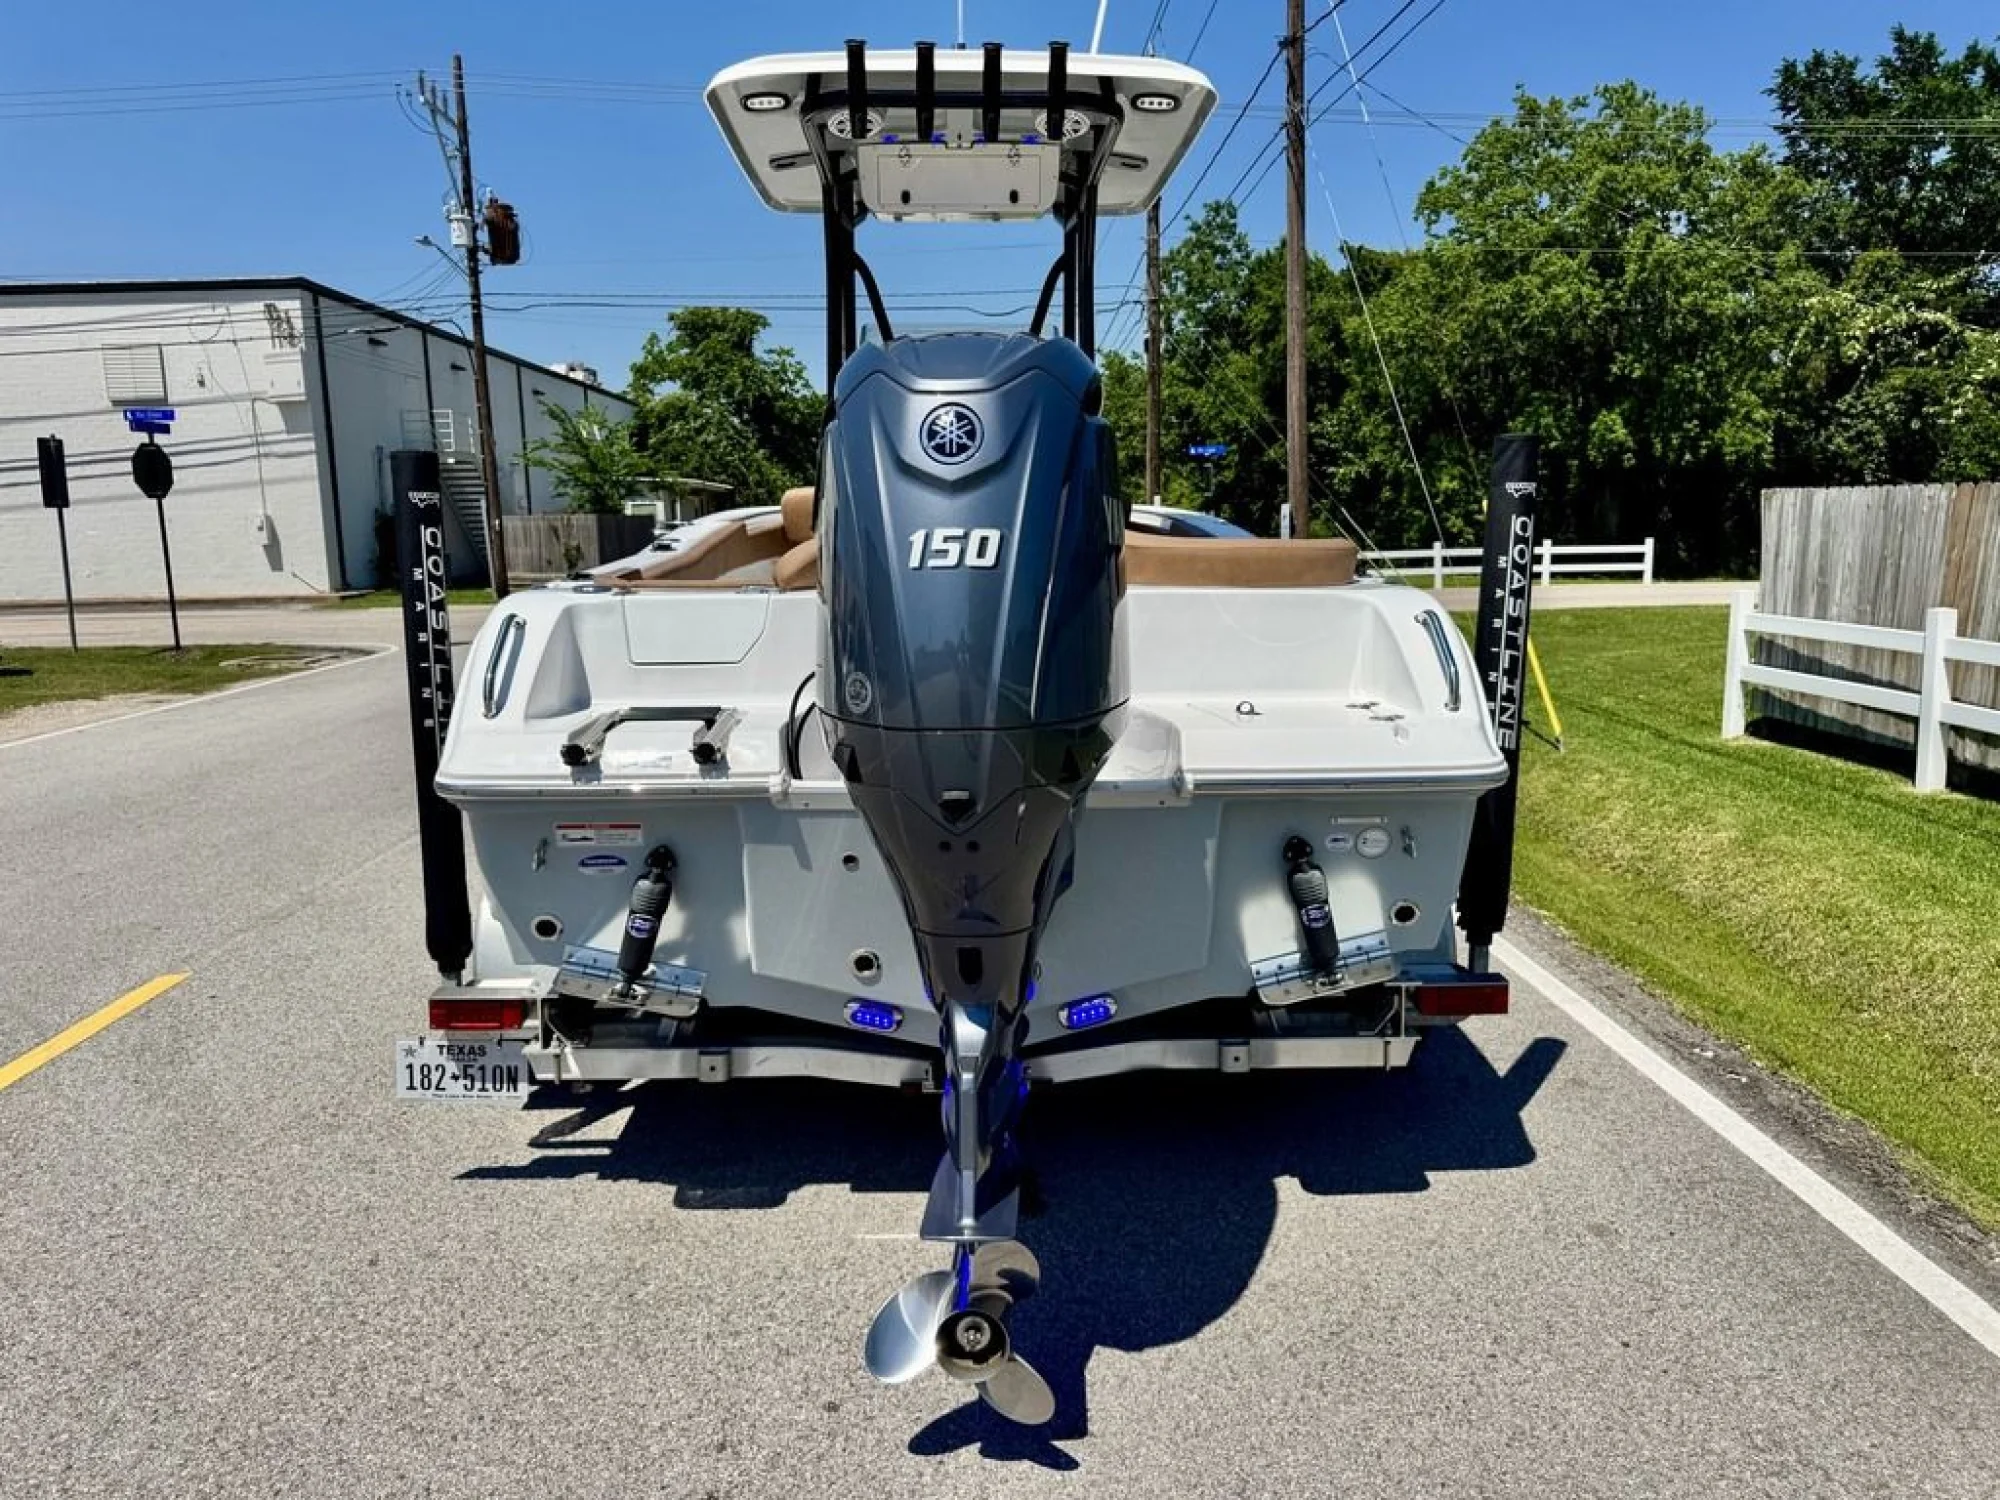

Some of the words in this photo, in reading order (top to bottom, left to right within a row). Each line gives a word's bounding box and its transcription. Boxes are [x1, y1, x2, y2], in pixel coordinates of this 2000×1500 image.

[908, 527, 1001, 569] 150
[412, 567, 435, 728] MARINE
[425, 526, 455, 742] COASTLI
[1499, 516, 1531, 750] COASTLINE
[437, 1044, 487, 1057] TEXAS
